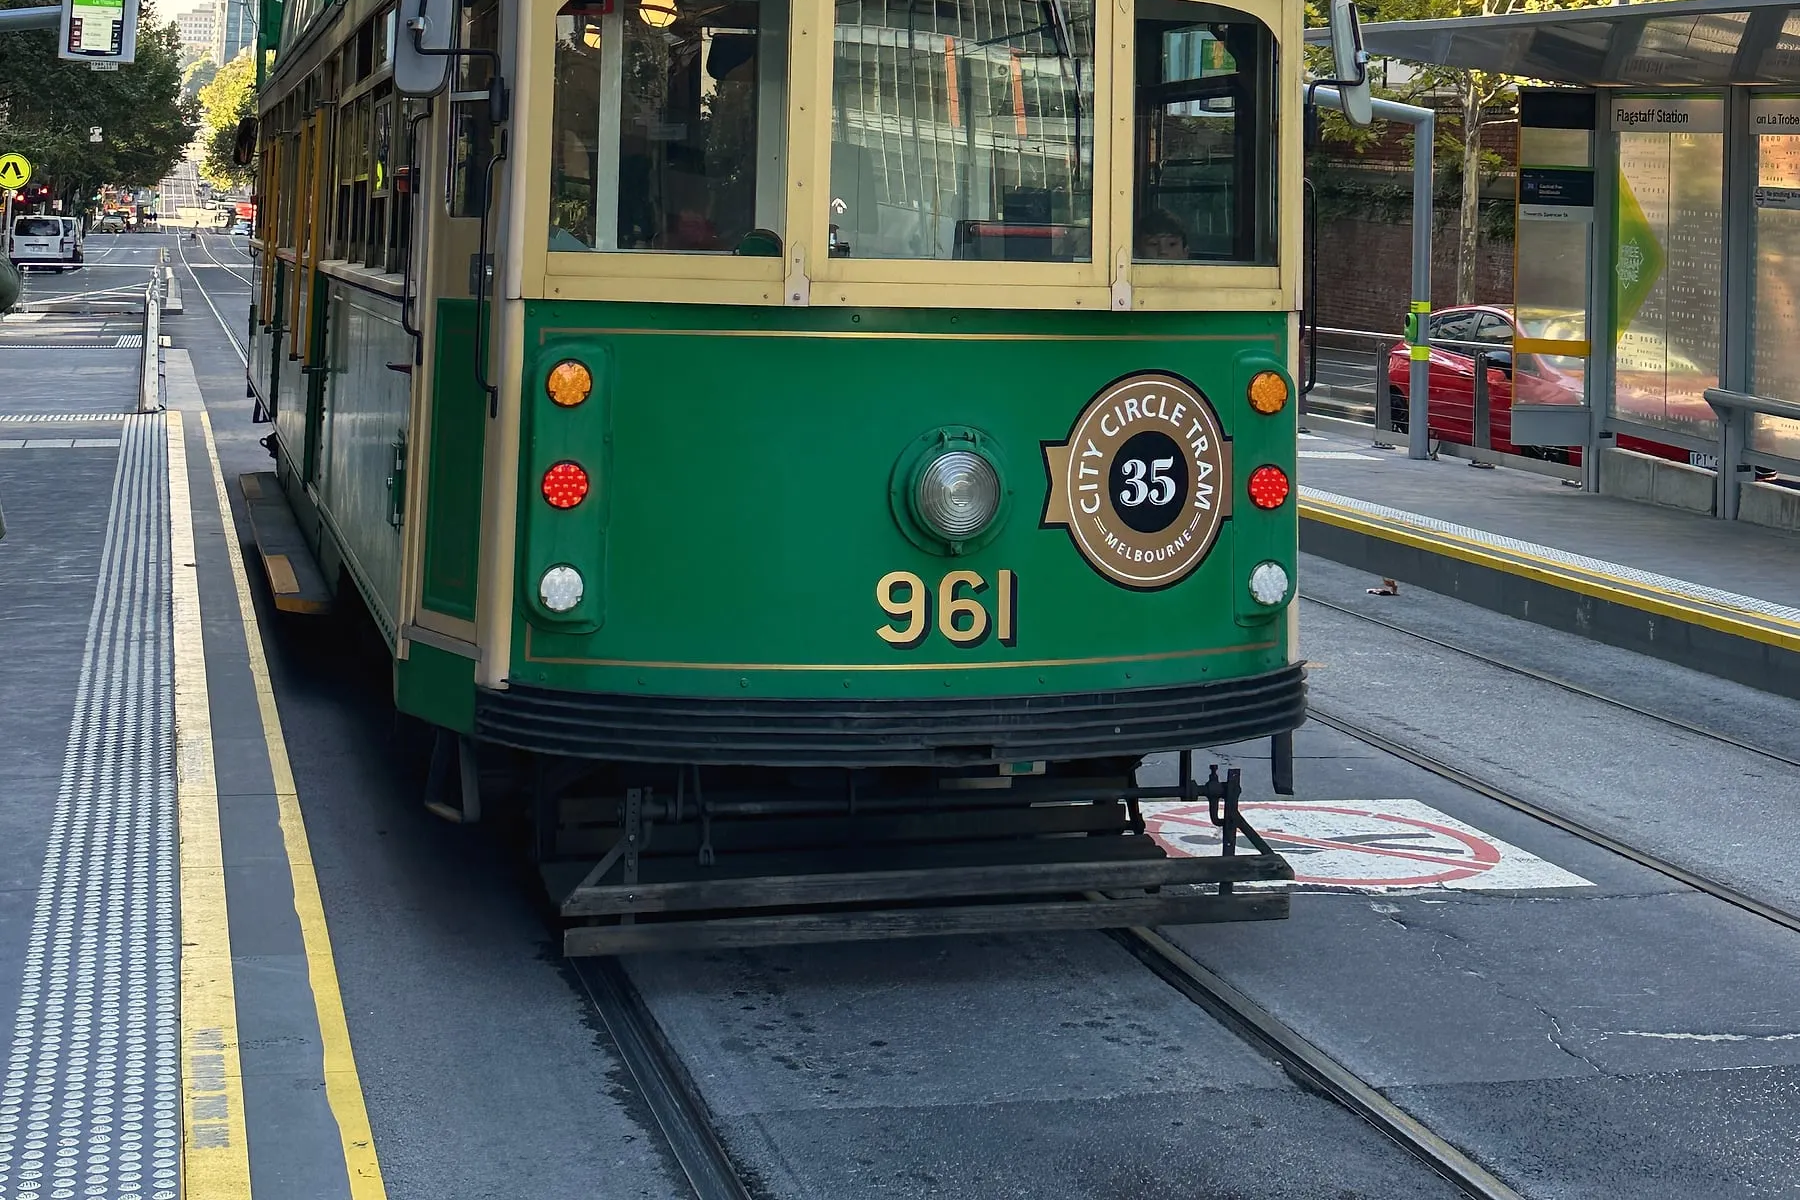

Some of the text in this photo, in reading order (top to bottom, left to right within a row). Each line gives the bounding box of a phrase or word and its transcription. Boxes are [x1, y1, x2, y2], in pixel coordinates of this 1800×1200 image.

[1616, 108, 1689, 126] Flagstaff Station
[1756, 114, 1800, 125] on La Trobe
[1078, 394, 1214, 514] CITY CIRCLE TRAM
[1119, 456, 1176, 507] 35
[1104, 529, 1192, 563] MELBOURNE
[876, 569, 1016, 648] 961
